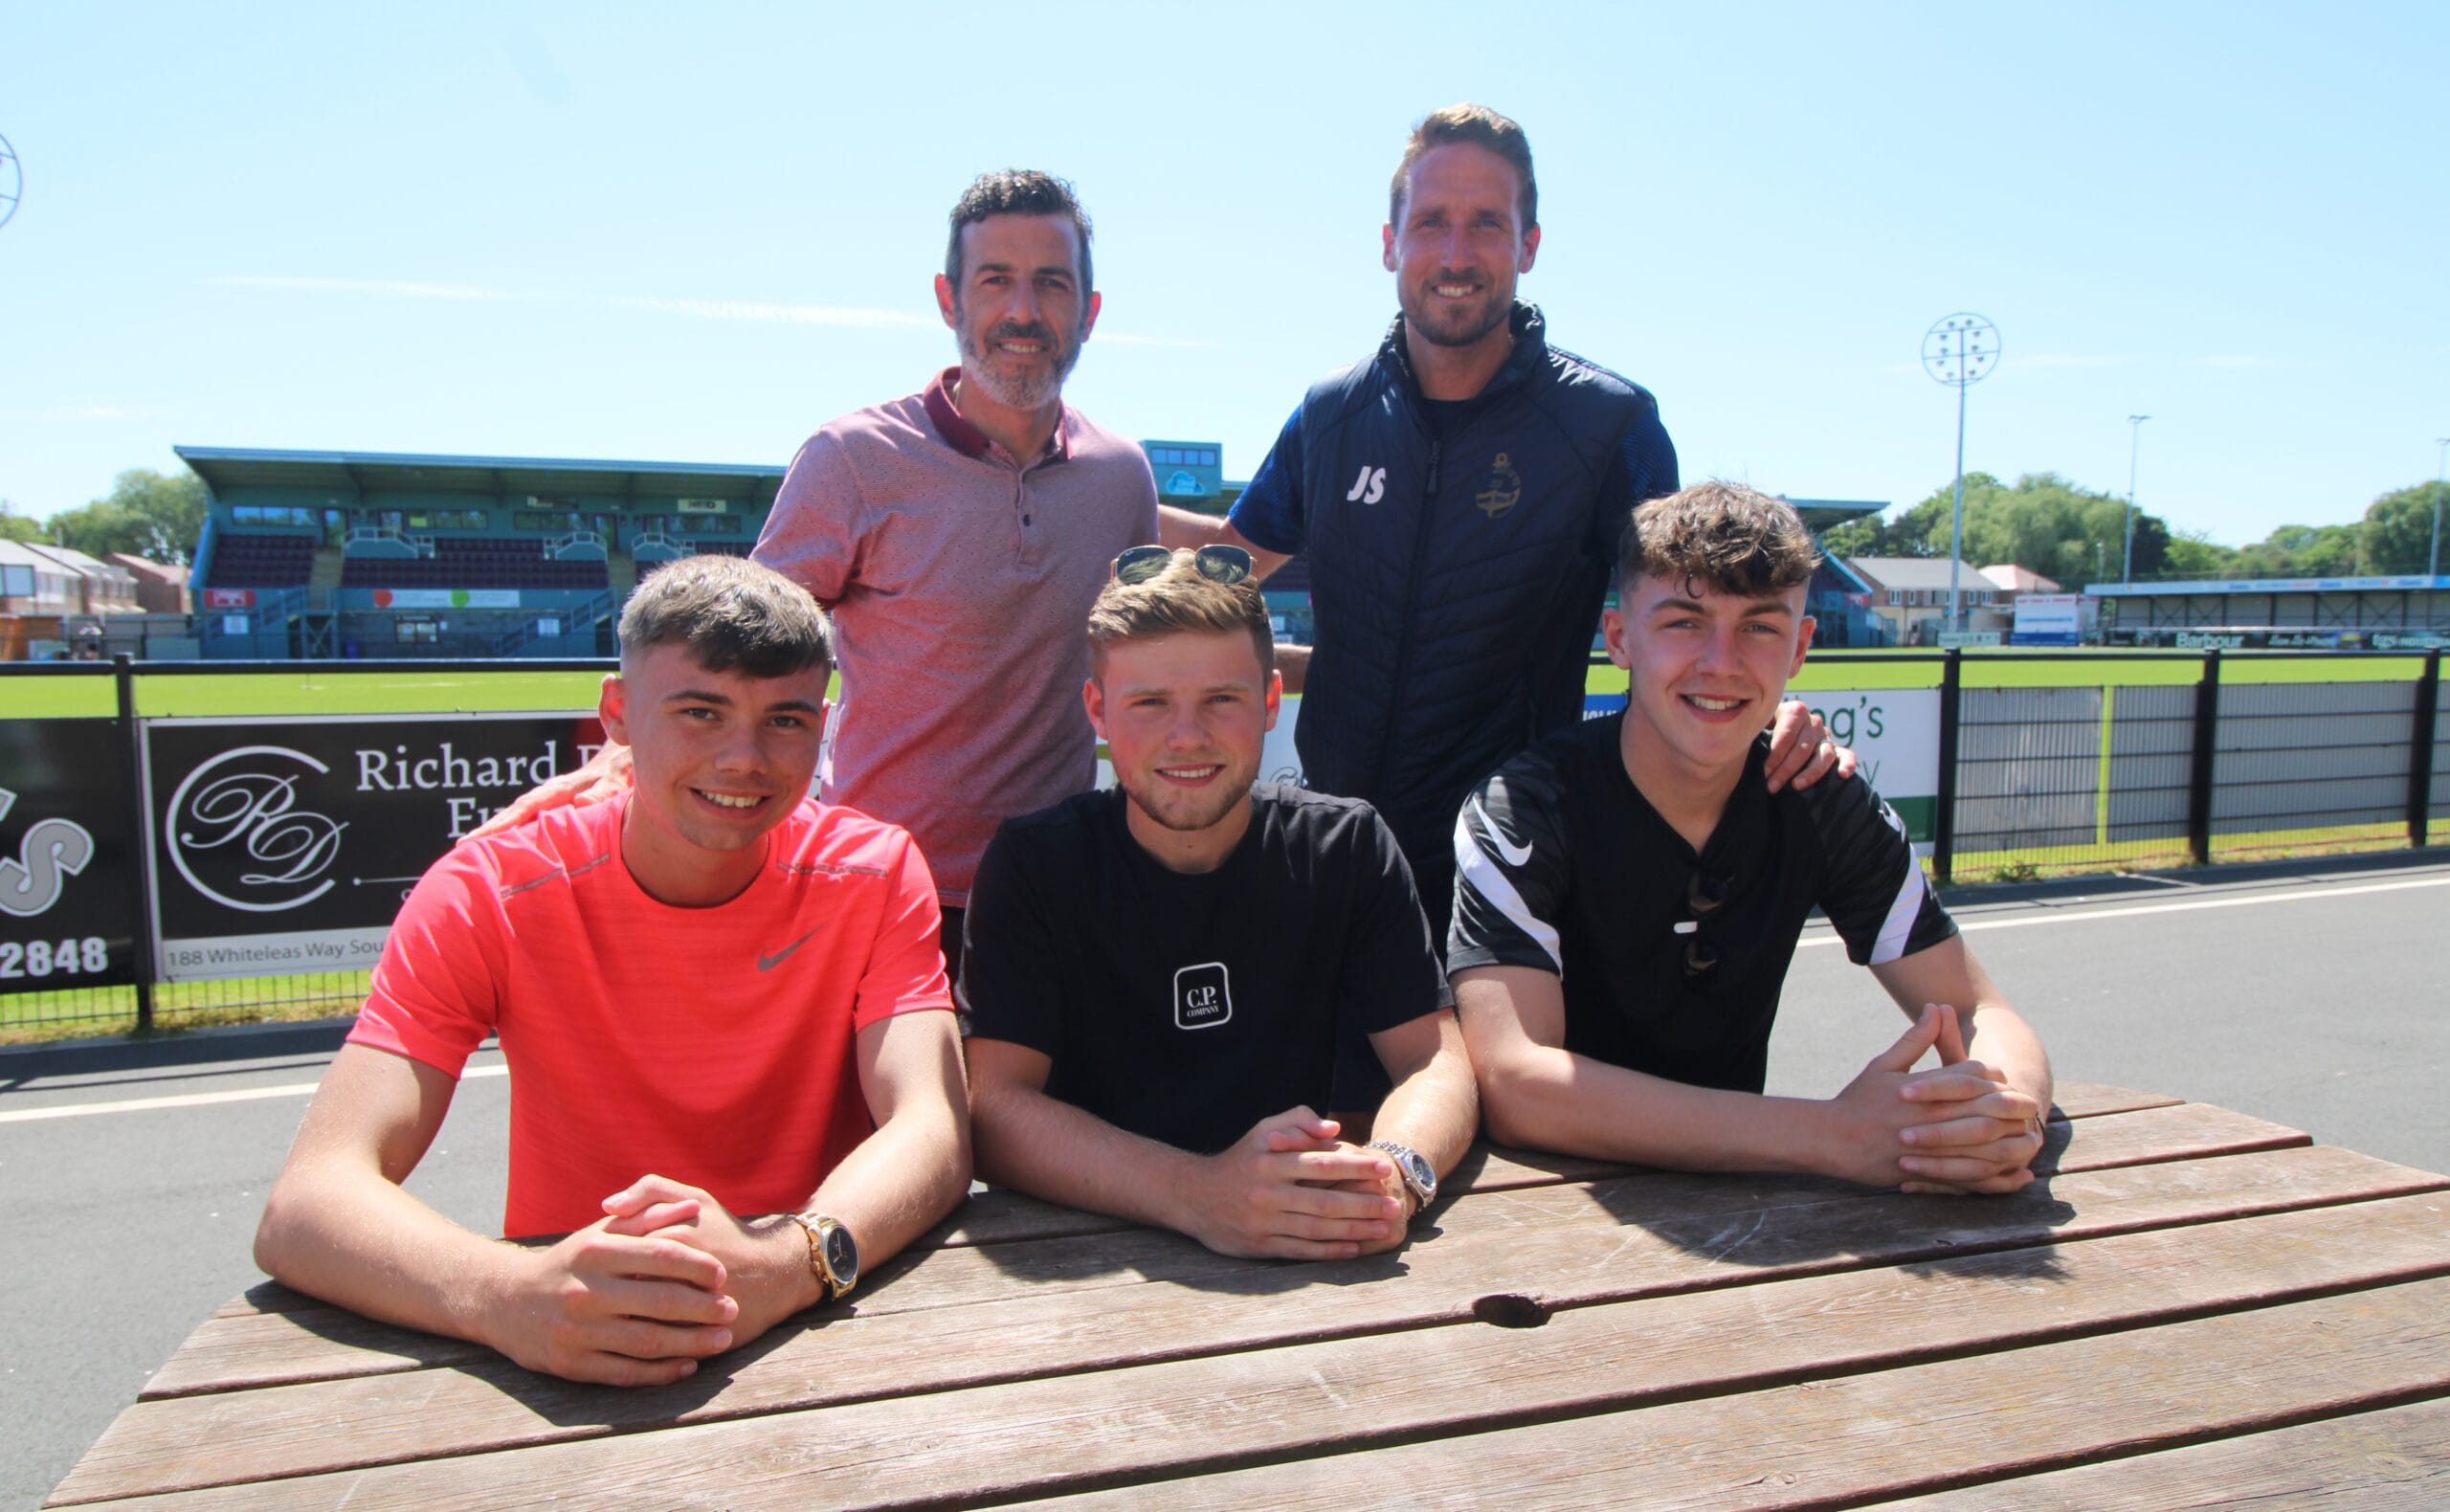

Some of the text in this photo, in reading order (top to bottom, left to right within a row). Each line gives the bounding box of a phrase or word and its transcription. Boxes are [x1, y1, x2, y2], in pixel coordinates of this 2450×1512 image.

[1346, 465, 1387, 505] JS
[2175, 632, 2244, 648] Barbour
[355, 740, 557, 791] Richard
[168, 950, 204, 967] 188
[207, 944, 301, 964] Whiteleas
[305, 941, 345, 959] Way
[1187, 986, 1216, 1008] C.P.
[1186, 1005, 1219, 1017] COMPANY
